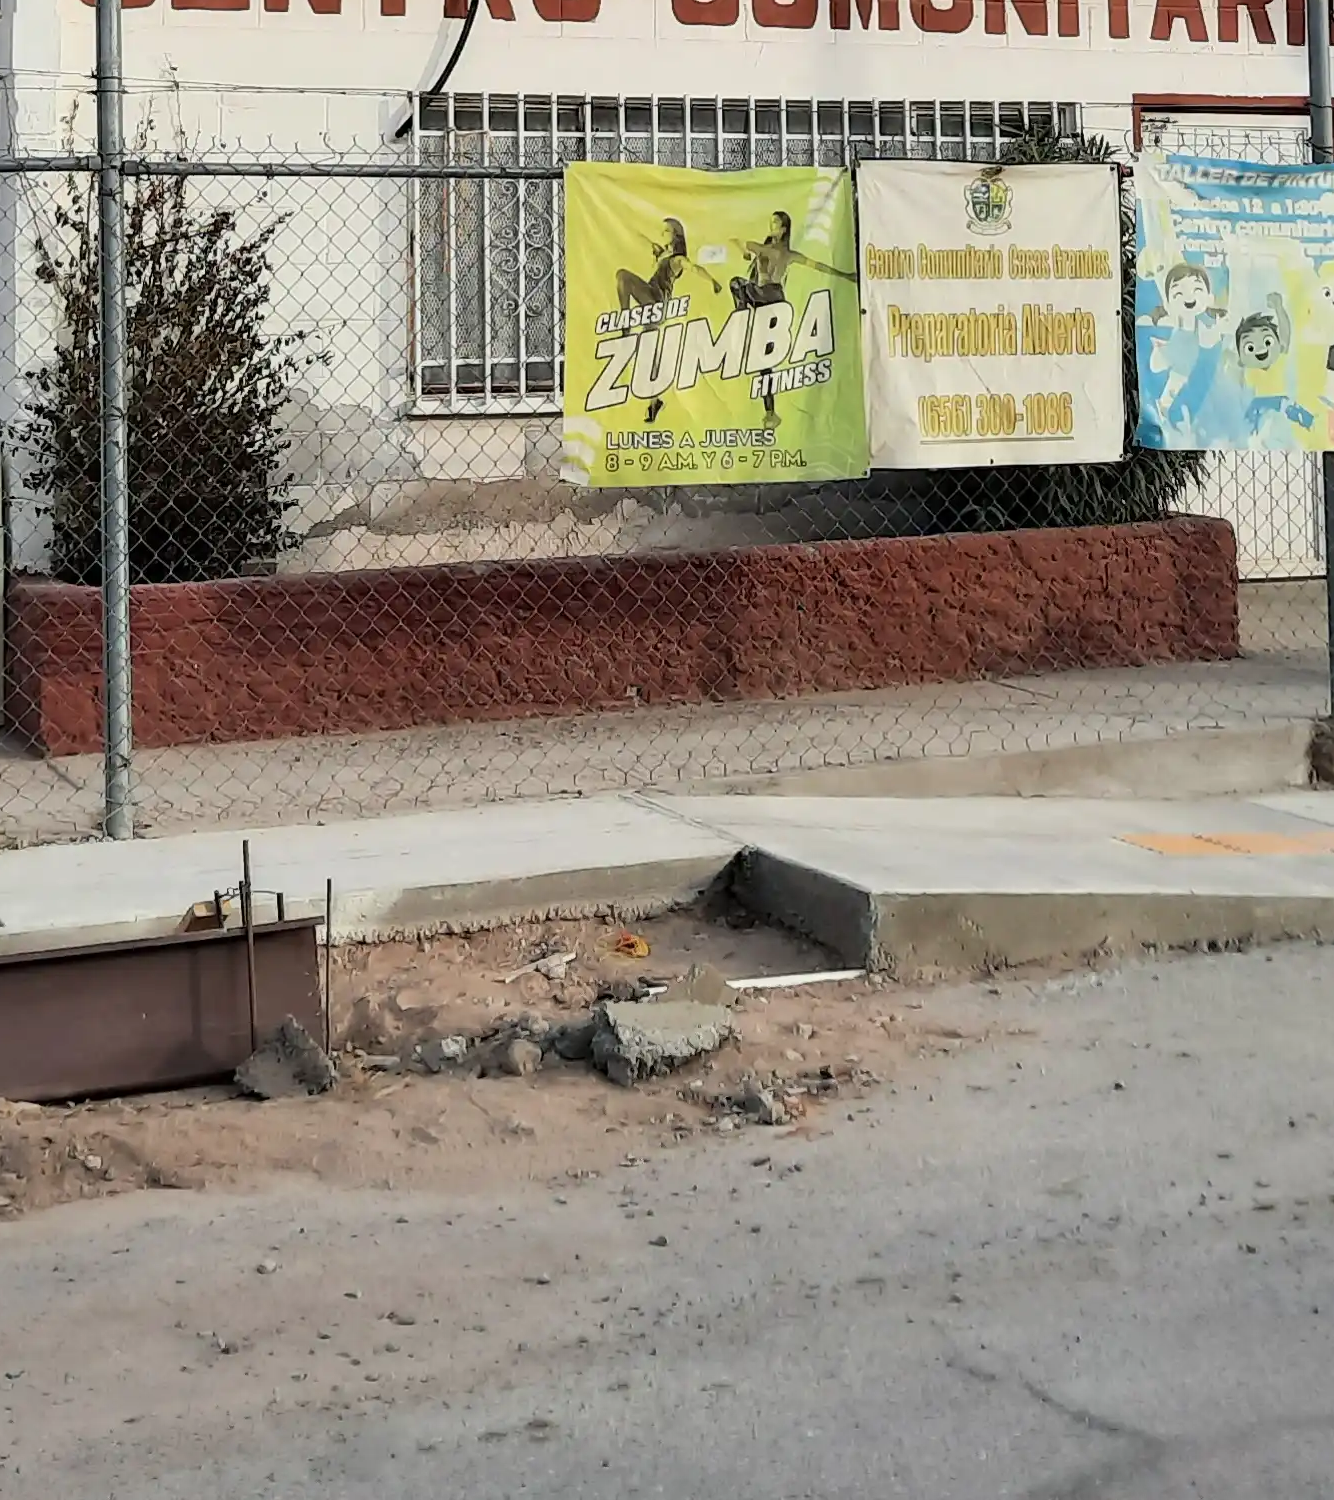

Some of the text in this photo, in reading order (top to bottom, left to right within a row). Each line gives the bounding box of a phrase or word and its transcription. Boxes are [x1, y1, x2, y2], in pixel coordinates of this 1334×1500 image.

[866, 243, 915, 280] Centro
[917, 243, 1004, 280] Comunitario
[1008, 243, 1051, 280] Casas
[595, 294, 691, 335] CLASES DE
[887, 303, 1097, 364] Preparatoria Abierta
[584, 288, 835, 413] ZUMBA
[749, 358, 833, 400] FITNESS
[605, 428, 777, 450] LUNES A JUEVES
[605, 453, 620, 472] 8
[638, 452, 654, 472] 9
[703, 450, 717, 469] Y
[720, 450, 735, 469] 6
[752, 450, 766, 469] 7
